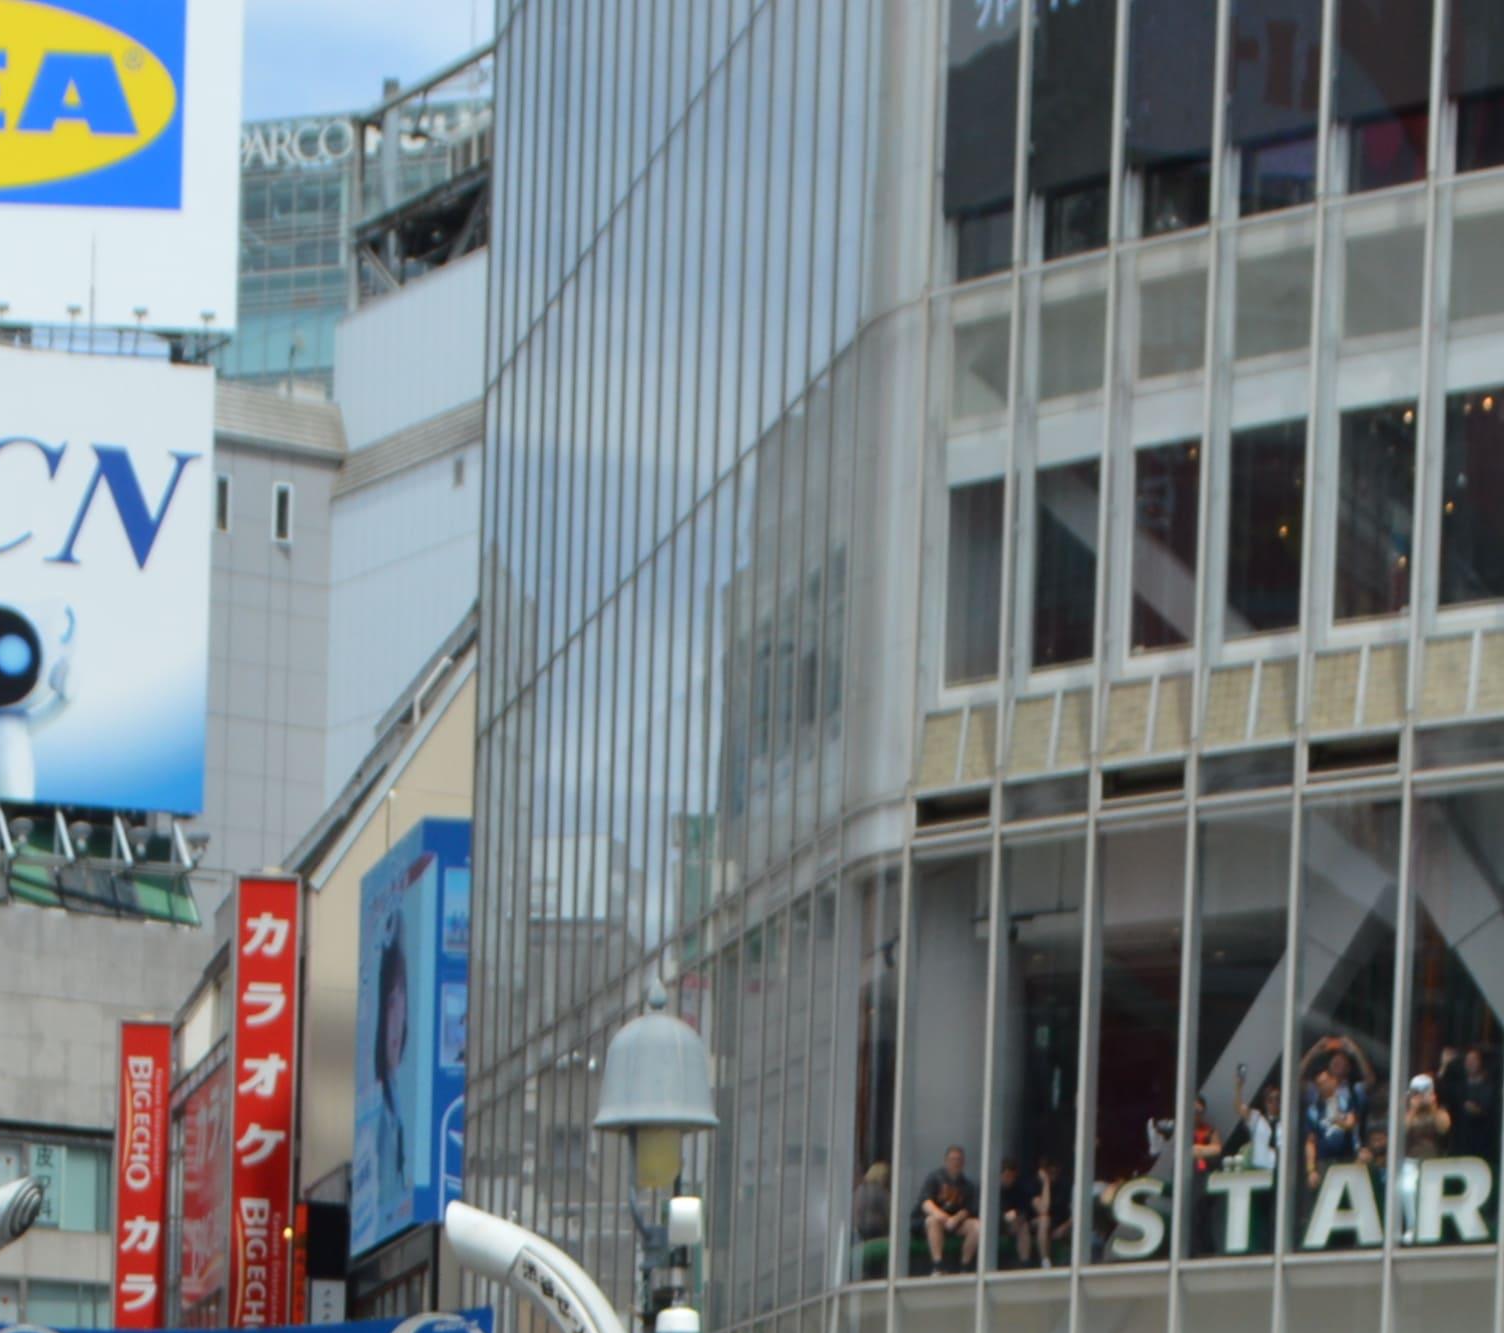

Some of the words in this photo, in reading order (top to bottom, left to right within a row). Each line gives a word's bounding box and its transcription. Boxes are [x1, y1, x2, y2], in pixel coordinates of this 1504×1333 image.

[235, 911, 290, 1168] カラオケ
[128, 1056, 154, 1108] BIG
[126, 1111, 152, 1191] ECHO
[121, 1215, 160, 1312] カラ
[240, 1197, 271, 1260] BIG
[241, 1264, 268, 1329] ECH
